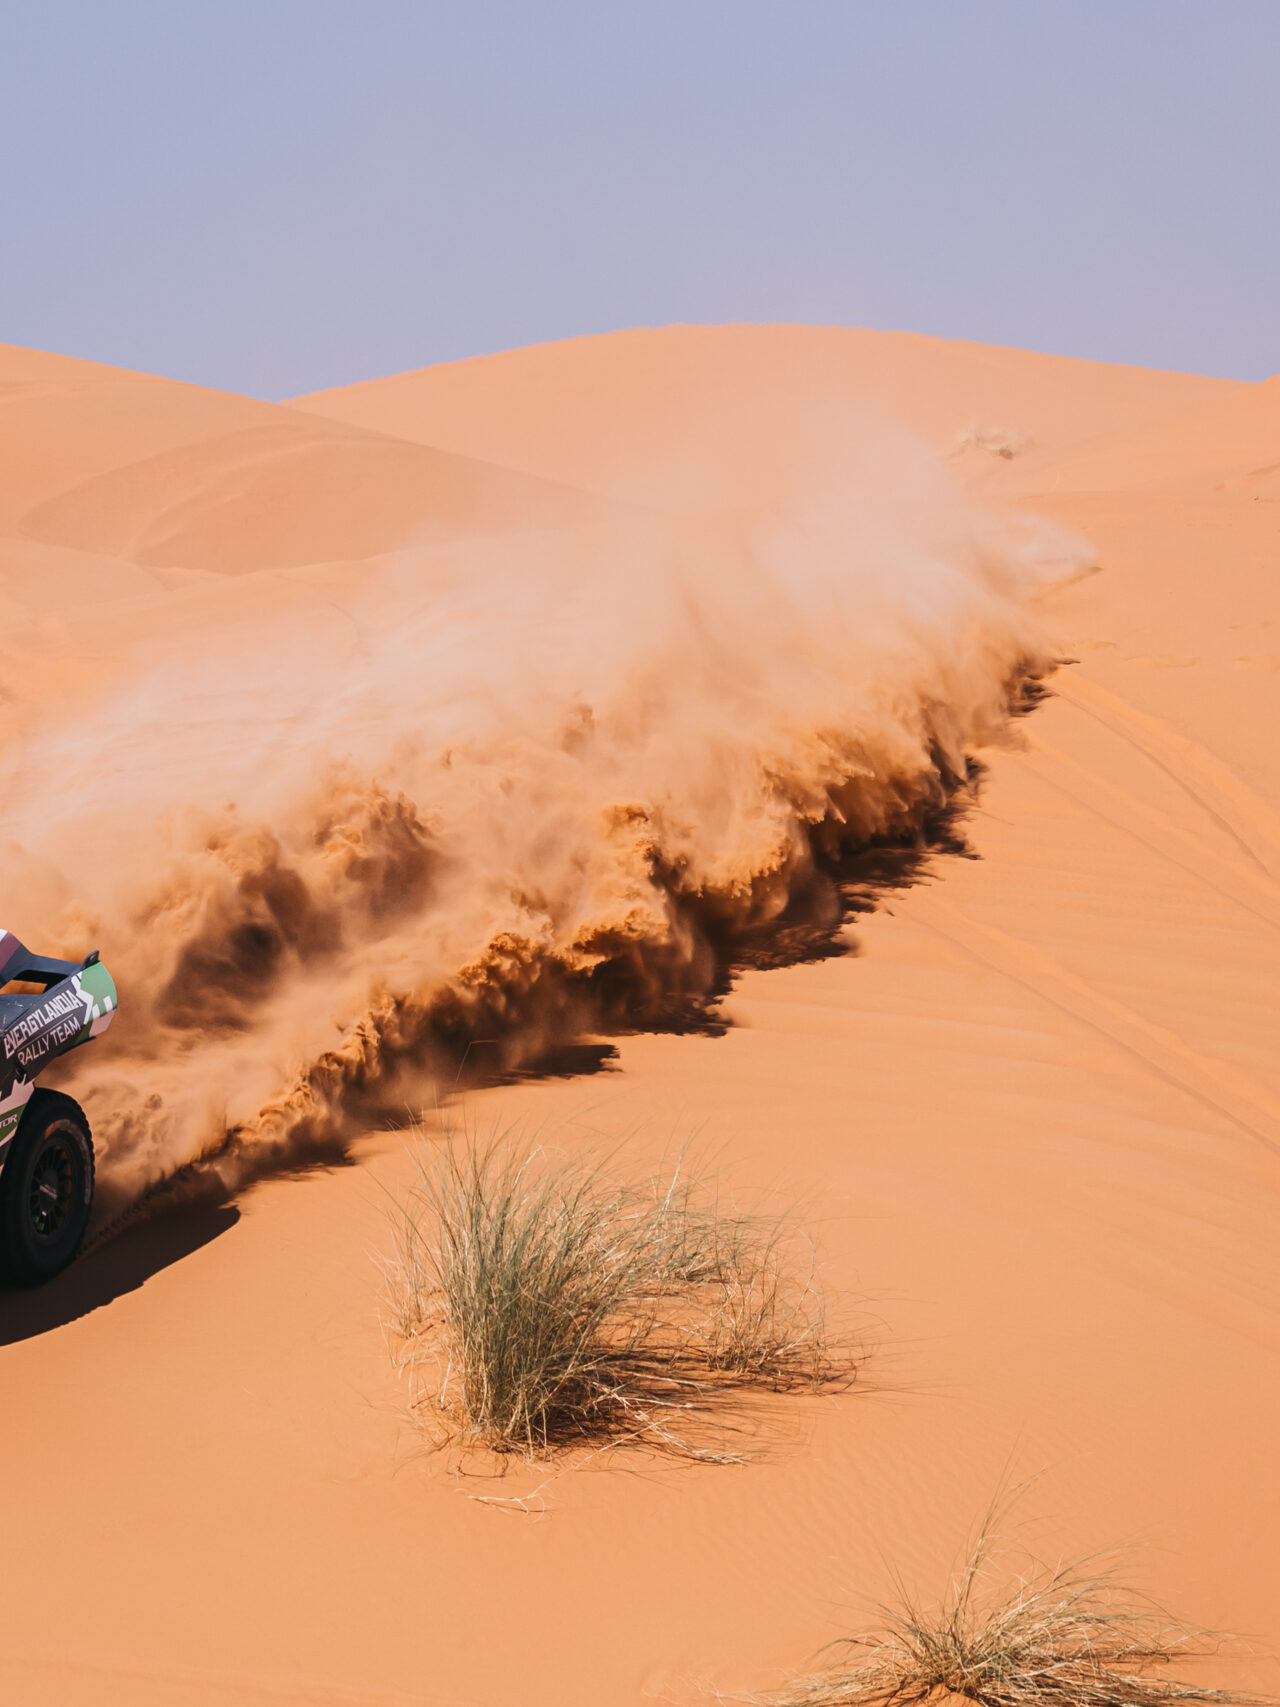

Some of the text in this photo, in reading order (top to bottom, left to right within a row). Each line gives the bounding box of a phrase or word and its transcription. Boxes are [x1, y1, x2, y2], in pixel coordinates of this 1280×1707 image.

[3, 989, 84, 1060] ENERGYLANDIA
[18, 1016, 81, 1066] RALLY TEAM
